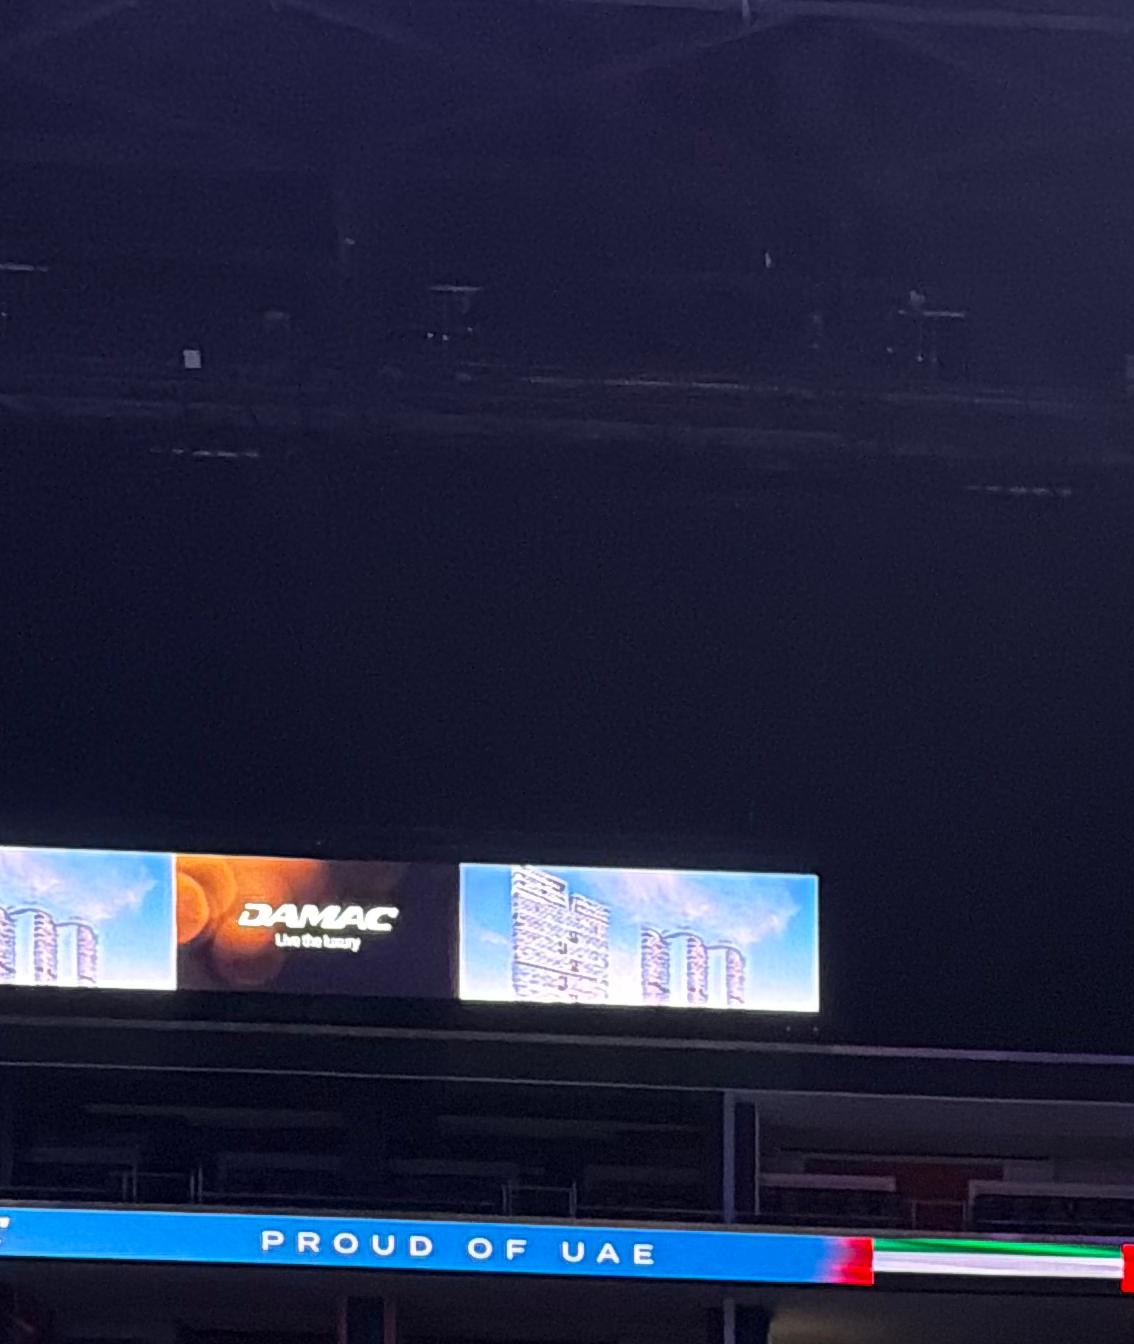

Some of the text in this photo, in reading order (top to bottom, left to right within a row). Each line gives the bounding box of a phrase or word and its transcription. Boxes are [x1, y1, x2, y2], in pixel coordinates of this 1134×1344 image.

[238, 902, 399, 932] DAMAC
[262, 1230, 654, 1265] PROUD OF UAE
